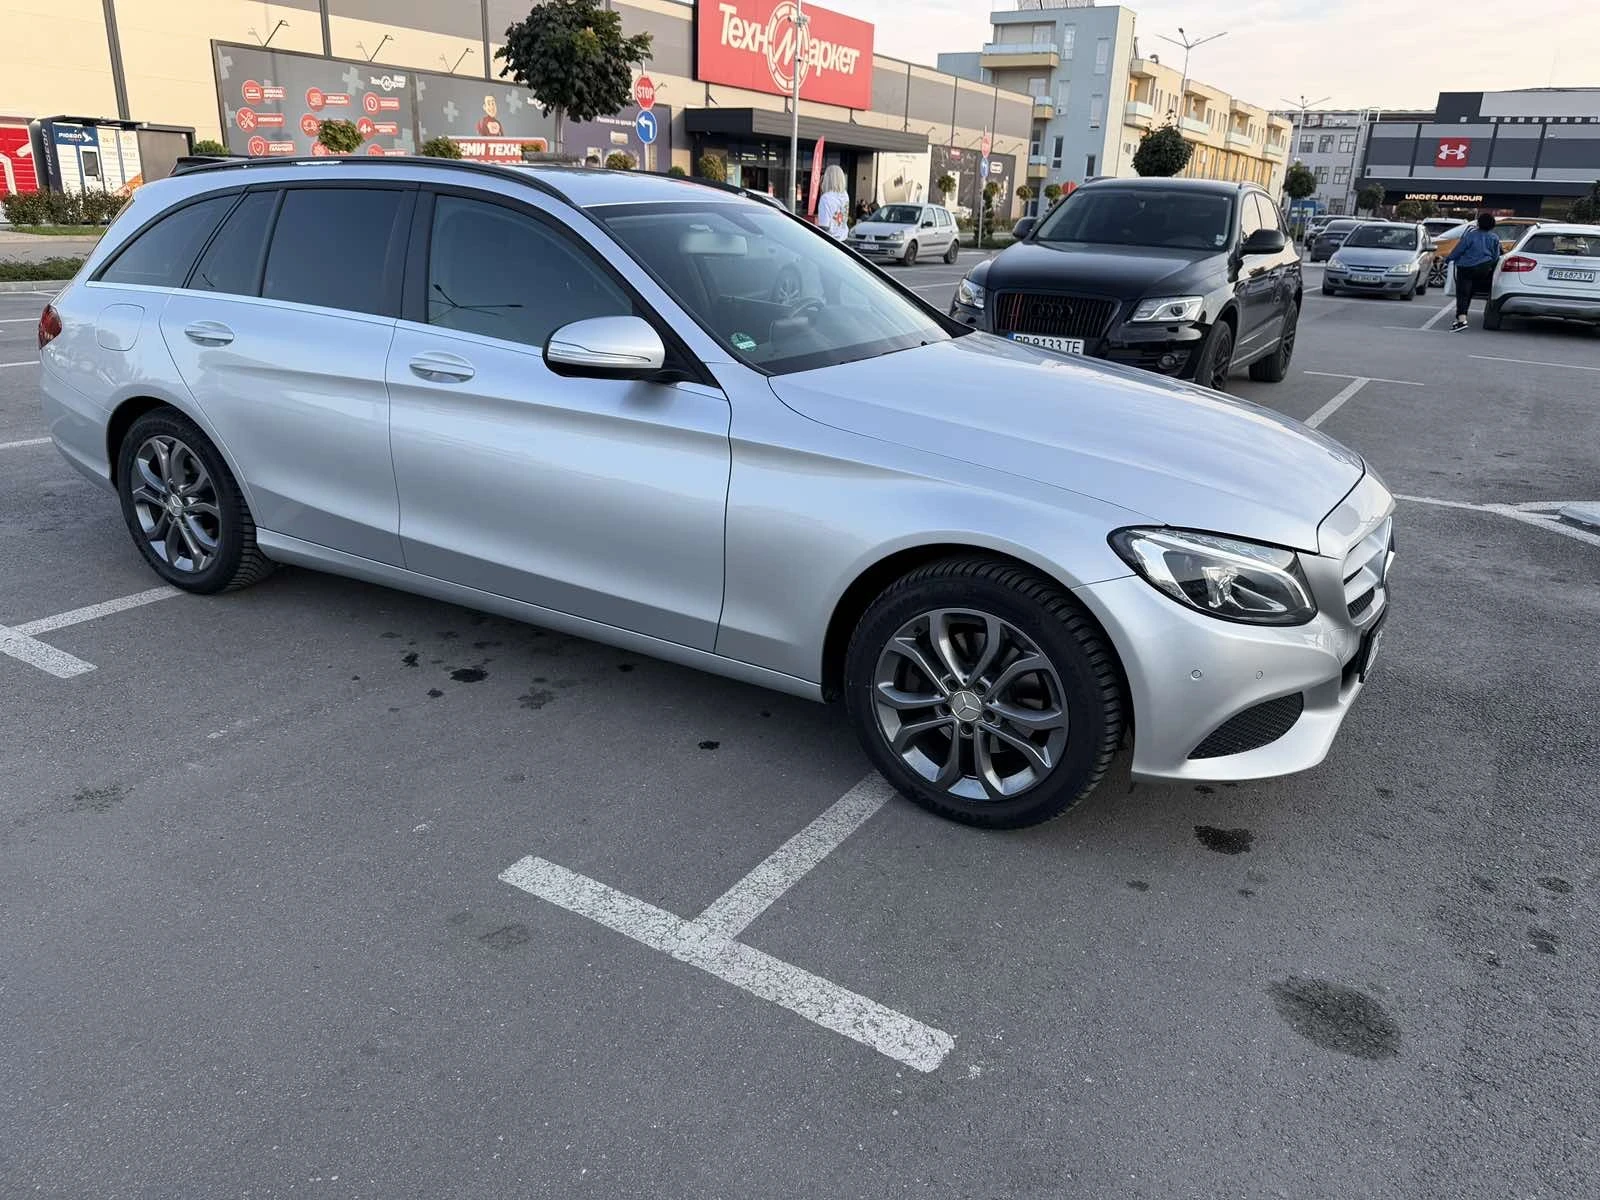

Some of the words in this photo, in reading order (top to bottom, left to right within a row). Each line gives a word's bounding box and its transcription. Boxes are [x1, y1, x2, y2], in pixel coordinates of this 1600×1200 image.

[637, 86, 654, 99] STOP
[487, 143, 522, 156] ТЕХН
[1440, 194, 1483, 202] ARMOUR
[1065, 341, 1081, 354] TE
